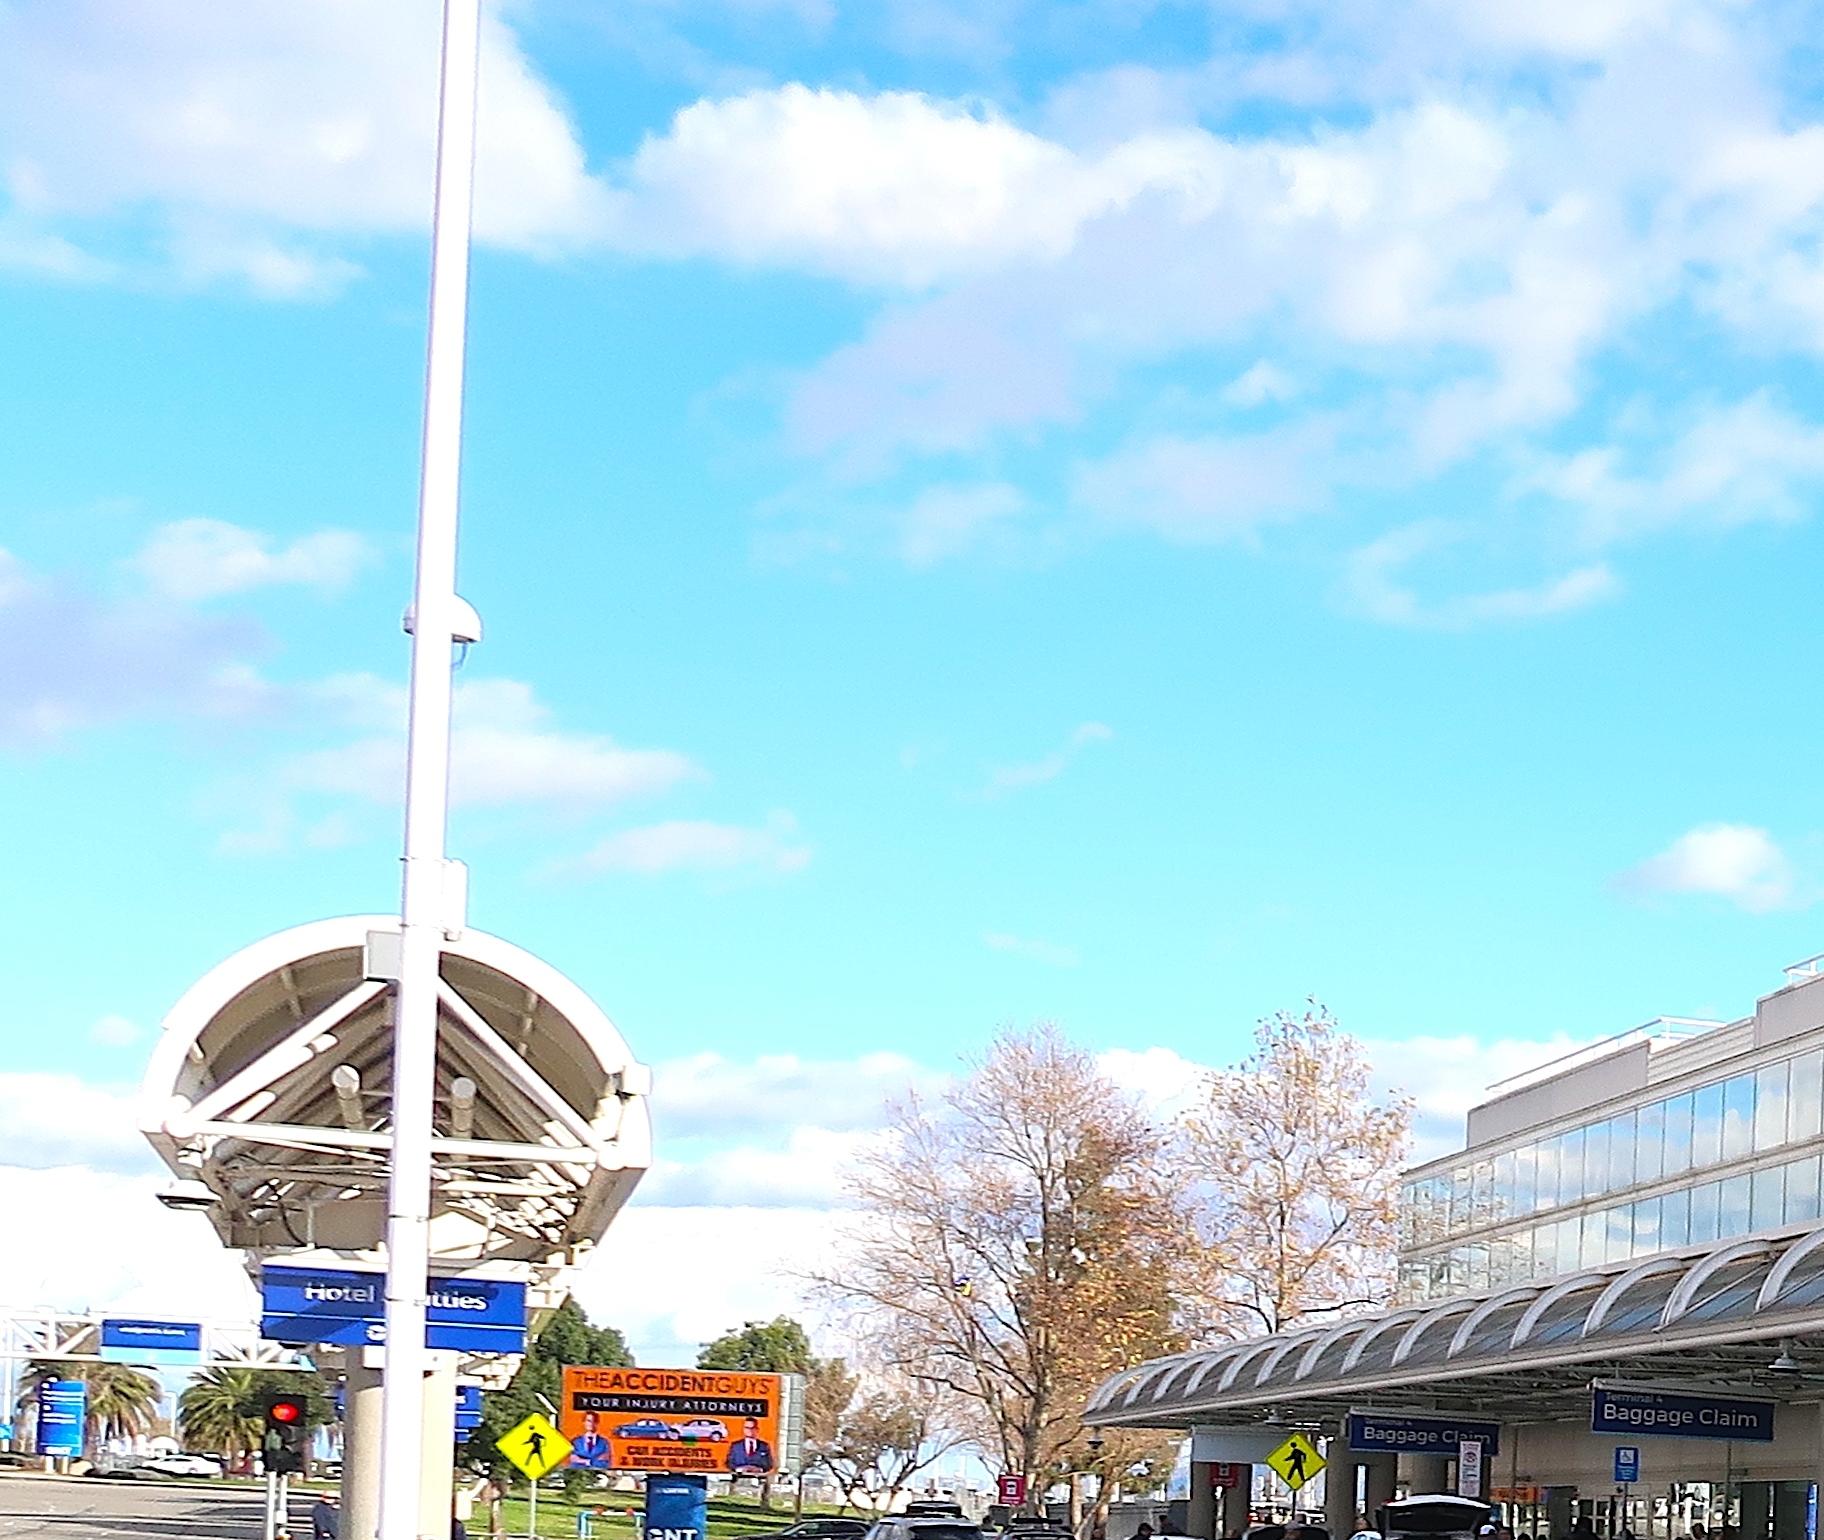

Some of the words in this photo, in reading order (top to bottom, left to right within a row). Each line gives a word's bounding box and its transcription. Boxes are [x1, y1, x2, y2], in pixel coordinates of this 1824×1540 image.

[304, 1281, 375, 1303] Hotel
[581, 1396, 620, 1408] YOUR
[626, 1399, 675, 1410] INJURY
[683, 1400, 763, 1414] ATTORNEYS
[1603, 1404, 1694, 1426] Baggage
[1699, 1409, 1758, 1428] Claim
[1364, 1426, 1438, 1445] Baggage
